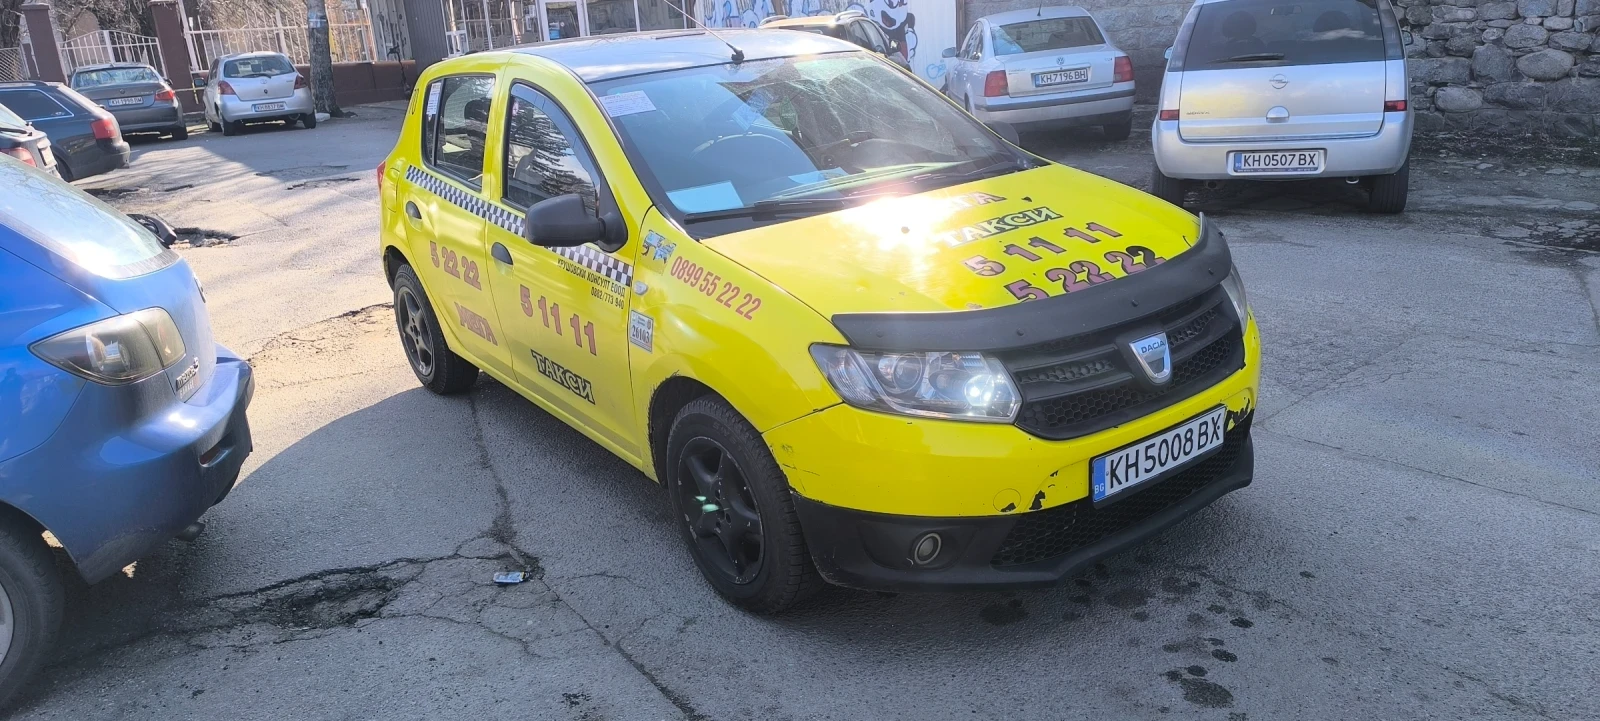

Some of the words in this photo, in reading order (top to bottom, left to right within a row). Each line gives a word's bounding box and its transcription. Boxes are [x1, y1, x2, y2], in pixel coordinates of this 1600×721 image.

[429, 240, 440, 269] 5
[441, 246, 461, 280] 22
[461, 256, 482, 291] 22
[960, 254, 1006, 277] 5
[1002, 236, 1067, 262] 11
[1063, 221, 1123, 243] 11
[1003, 279, 1050, 303] 5
[1045, 260, 1117, 293] 22
[1104, 245, 1168, 275] 22
[670, 256, 704, 288] 0899
[699, 271, 721, 297] 55
[716, 282, 741, 309] 22
[735, 293, 762, 320] 22
[520, 284, 533, 317] 5
[538, 295, 562, 336] 11
[569, 312, 597, 356] 11
[1140, 340, 1166, 354] DACIA
[530, 348, 596, 405] ТАКСИ
[1094, 482, 1105, 495] BG
